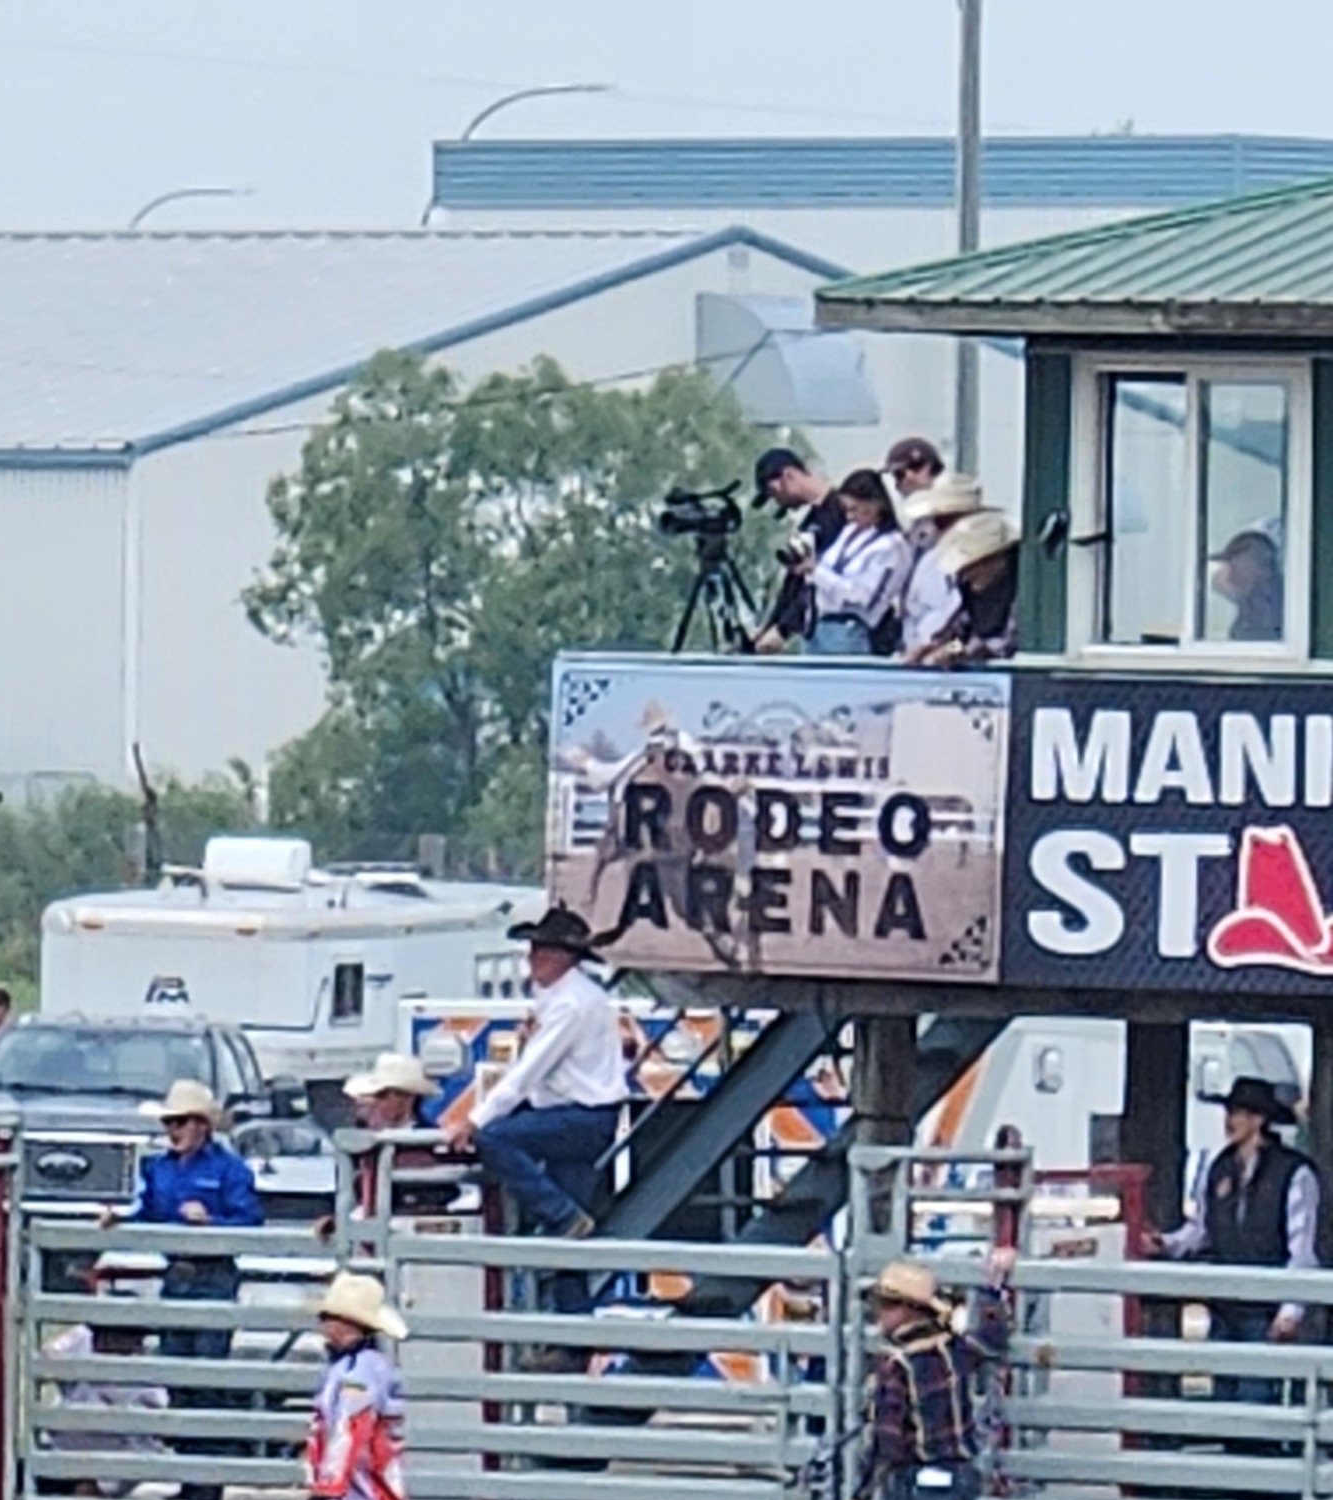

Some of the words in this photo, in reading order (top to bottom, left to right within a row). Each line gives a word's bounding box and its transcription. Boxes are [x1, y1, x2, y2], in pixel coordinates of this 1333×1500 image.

[1030, 707, 1333, 807] MANI
[622, 782, 933, 858] RODEO
[617, 860, 928, 940] ARENA
